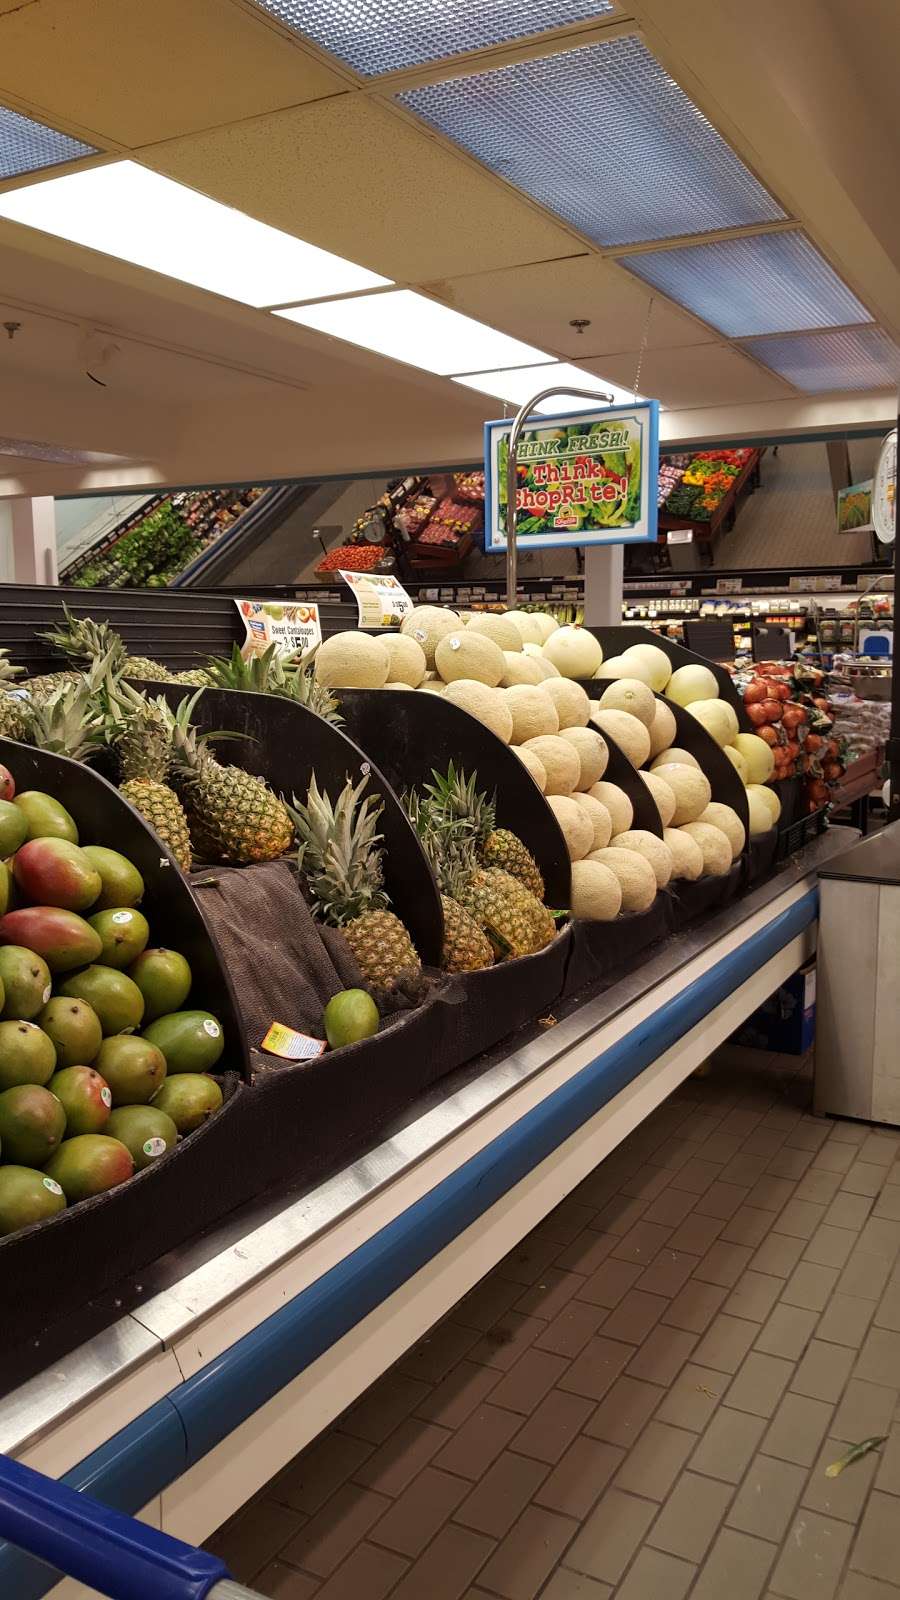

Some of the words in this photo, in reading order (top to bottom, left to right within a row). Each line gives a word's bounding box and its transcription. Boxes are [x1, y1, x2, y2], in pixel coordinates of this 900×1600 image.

[517, 439, 560, 458] HINK
[568, 431, 629, 452] FRESH!
[533, 456, 601, 485] Think
[272, 626, 286, 635] Sweet
[287, 626, 314, 636] Cantaloupes
